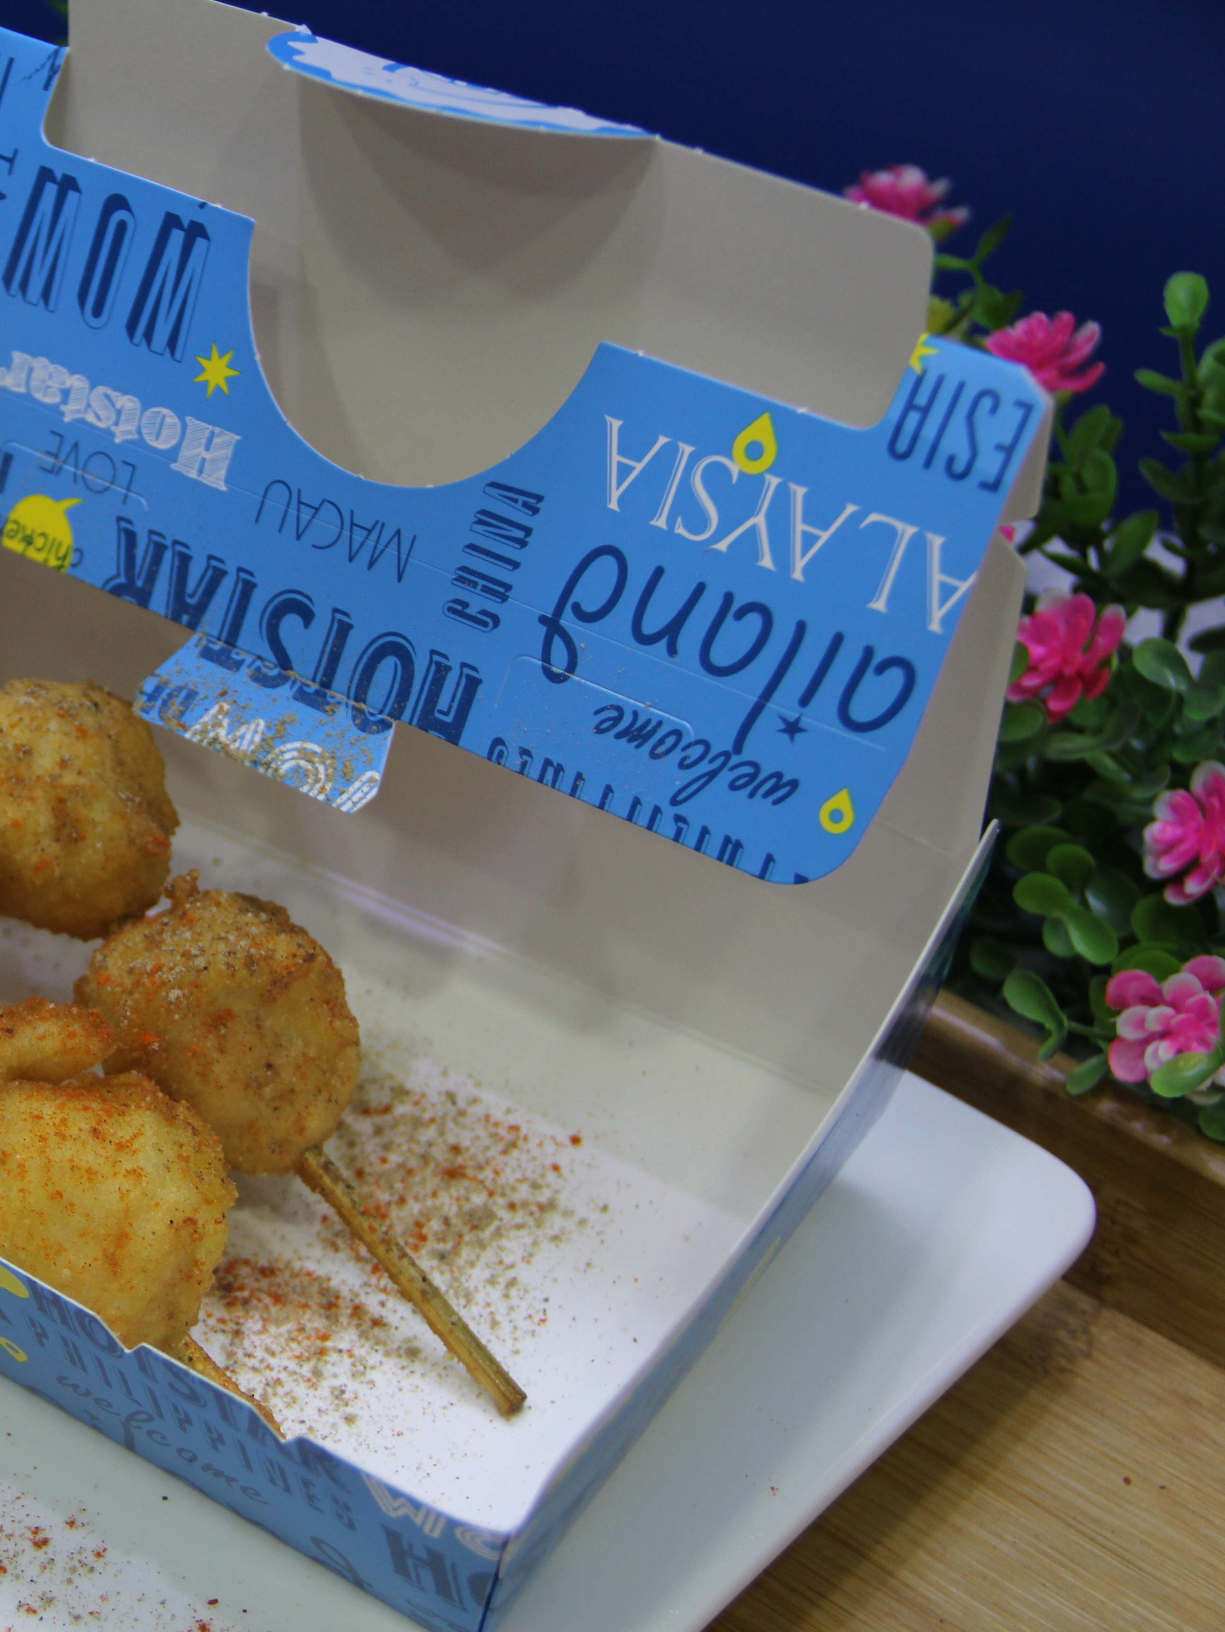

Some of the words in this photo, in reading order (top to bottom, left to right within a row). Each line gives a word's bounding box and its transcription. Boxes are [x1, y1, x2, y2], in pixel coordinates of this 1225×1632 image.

[39, 430, 137, 504] LOVE
[255, 479, 417, 583] MACAU
[604, 414, 977, 634] ALAYSIA
[442, 481, 545, 633] CHINA
[101, 516, 482, 746] HOTSTAR
[592, 703, 800, 807] welcome
[22, 1312, 356, 1531] PHILIPPINES
[55, 1373, 267, 1501] welcome
